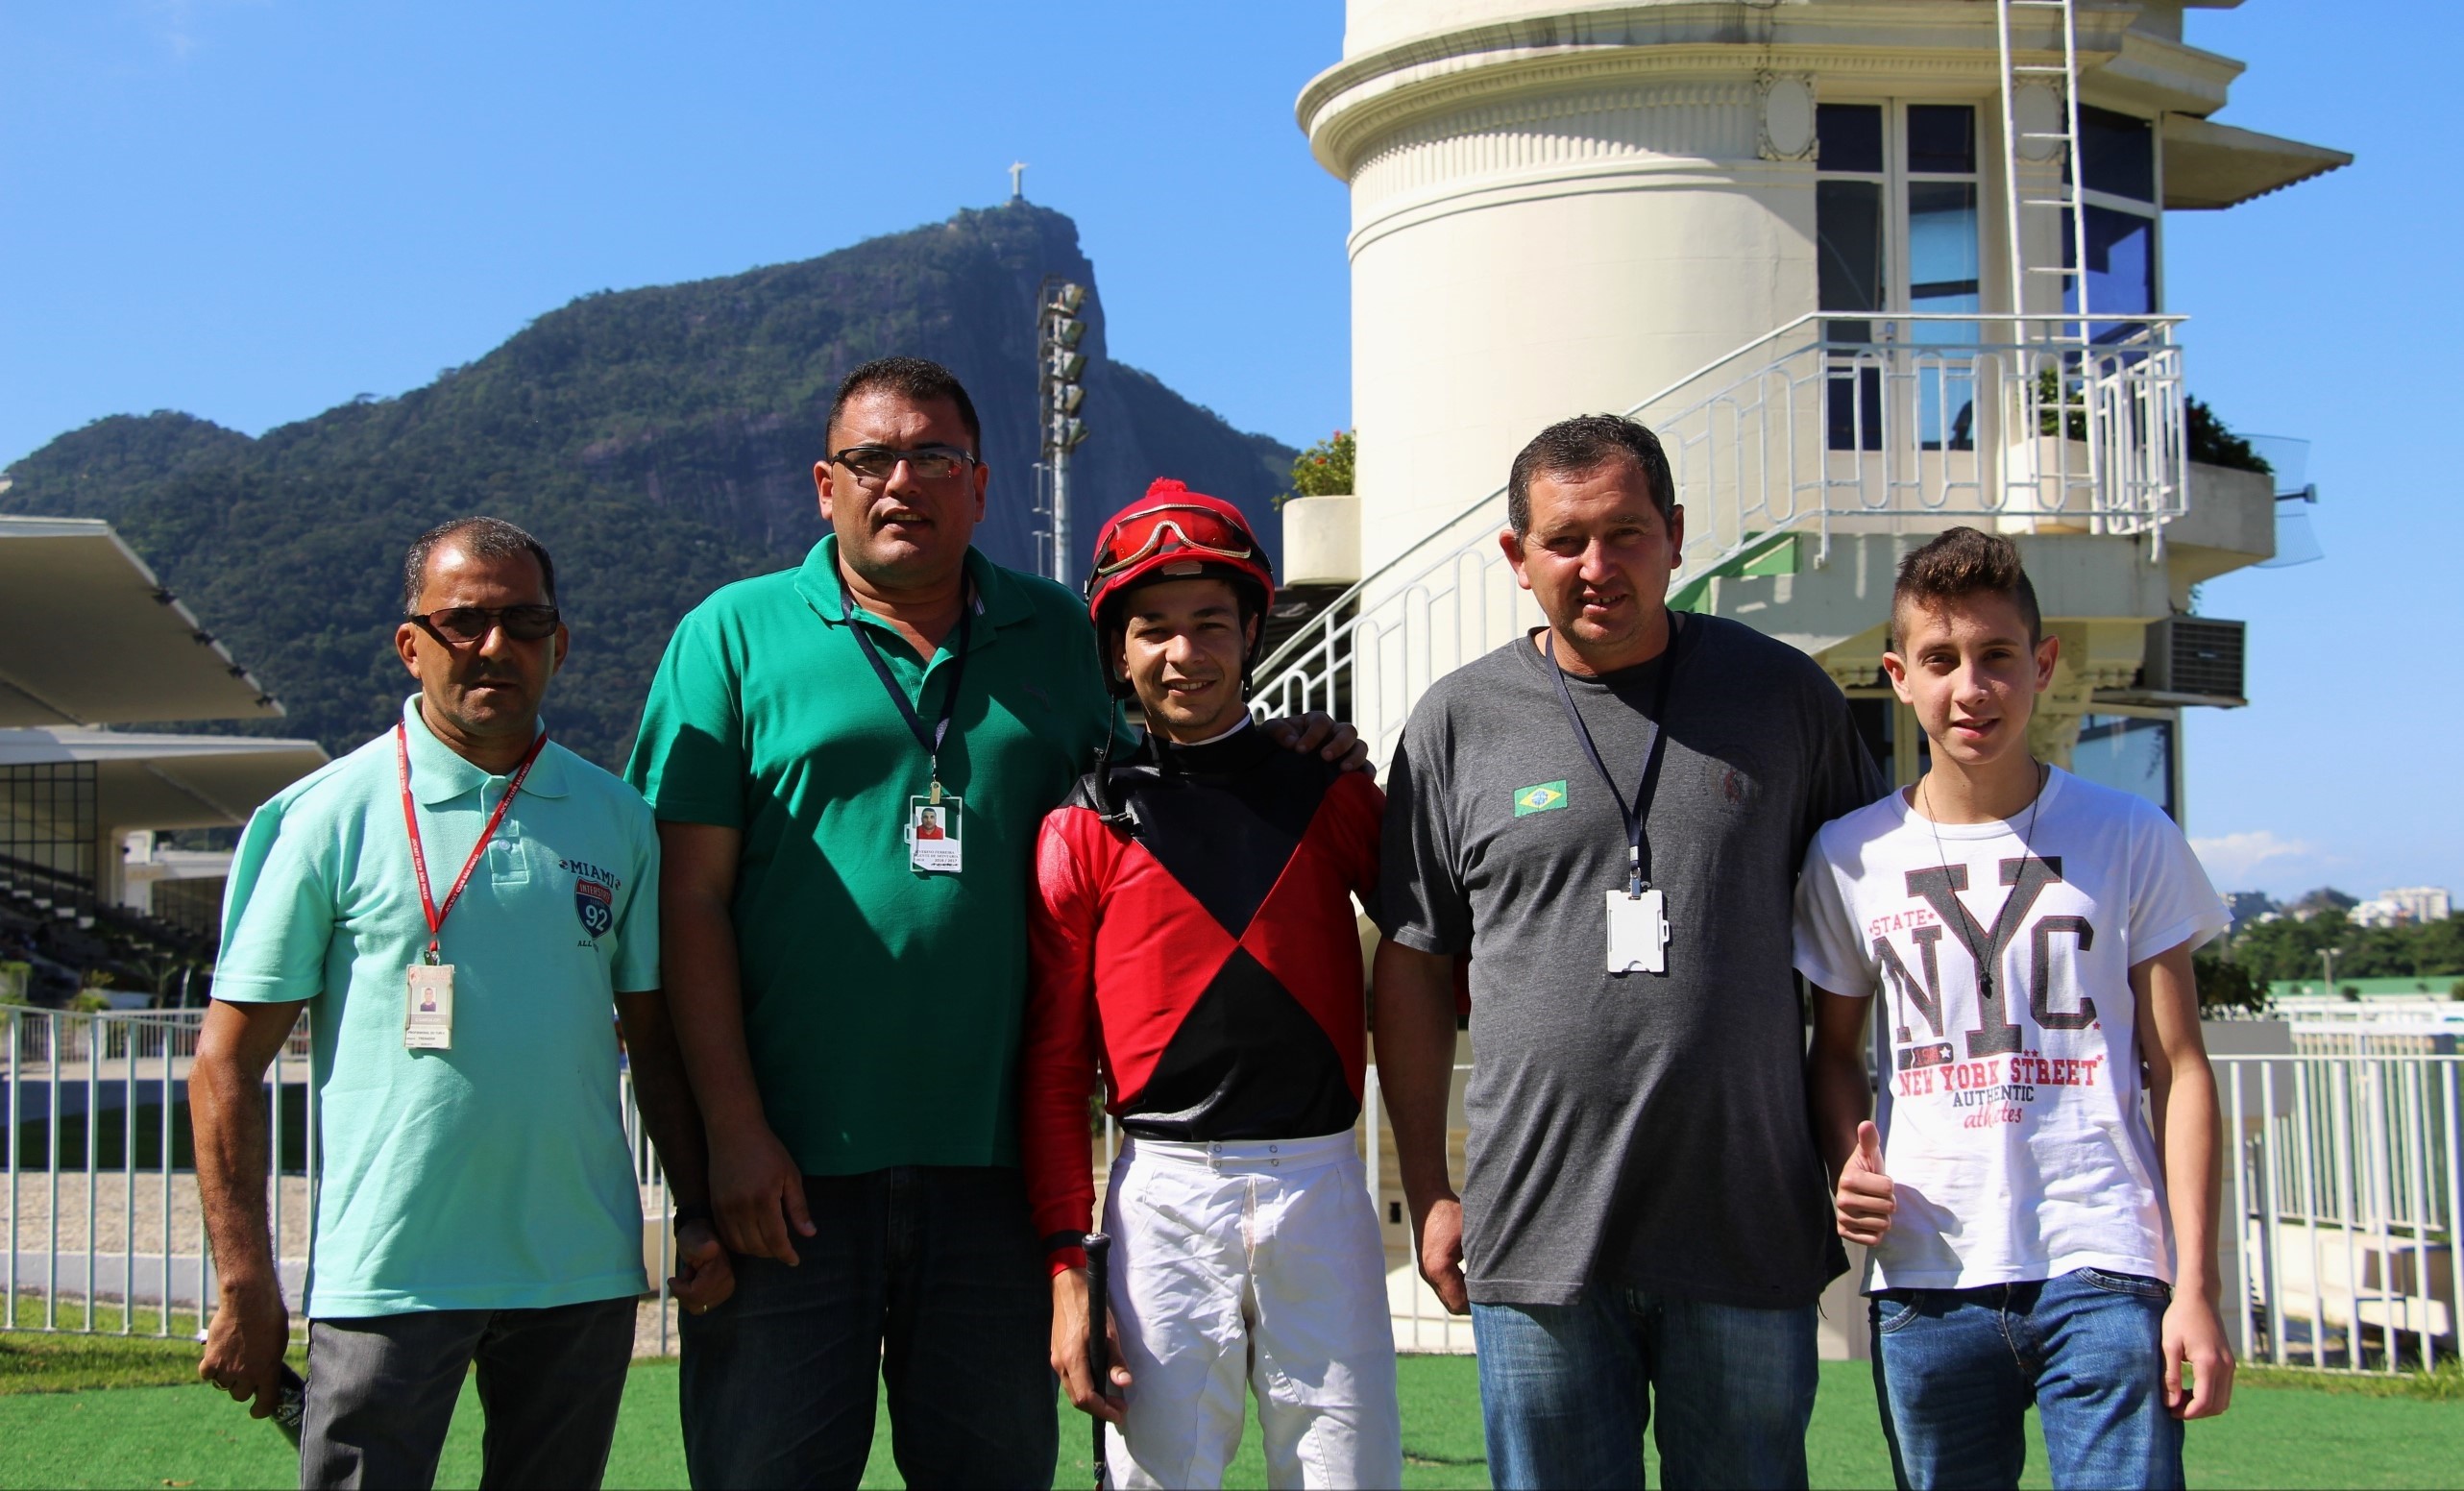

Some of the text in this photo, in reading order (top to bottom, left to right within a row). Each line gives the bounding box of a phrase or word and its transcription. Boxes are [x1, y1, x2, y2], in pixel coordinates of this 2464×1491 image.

[509, 786, 519, 797] CLUB
[411, 838, 420, 857] JOCKEY
[455, 879, 466, 892] CLUB
[469, 854, 479, 869] PAULO
[570, 860, 615, 889] MIAMI
[585, 904, 608, 932] 92
[1872, 909, 1927, 936] STATE
[1872, 856, 2097, 1059] NYC
[1898, 1059, 2099, 1097] NEW YORK STREET
[1953, 1085, 2035, 1108] AUTHENTIC
[1964, 1100, 2022, 1129] athletes
